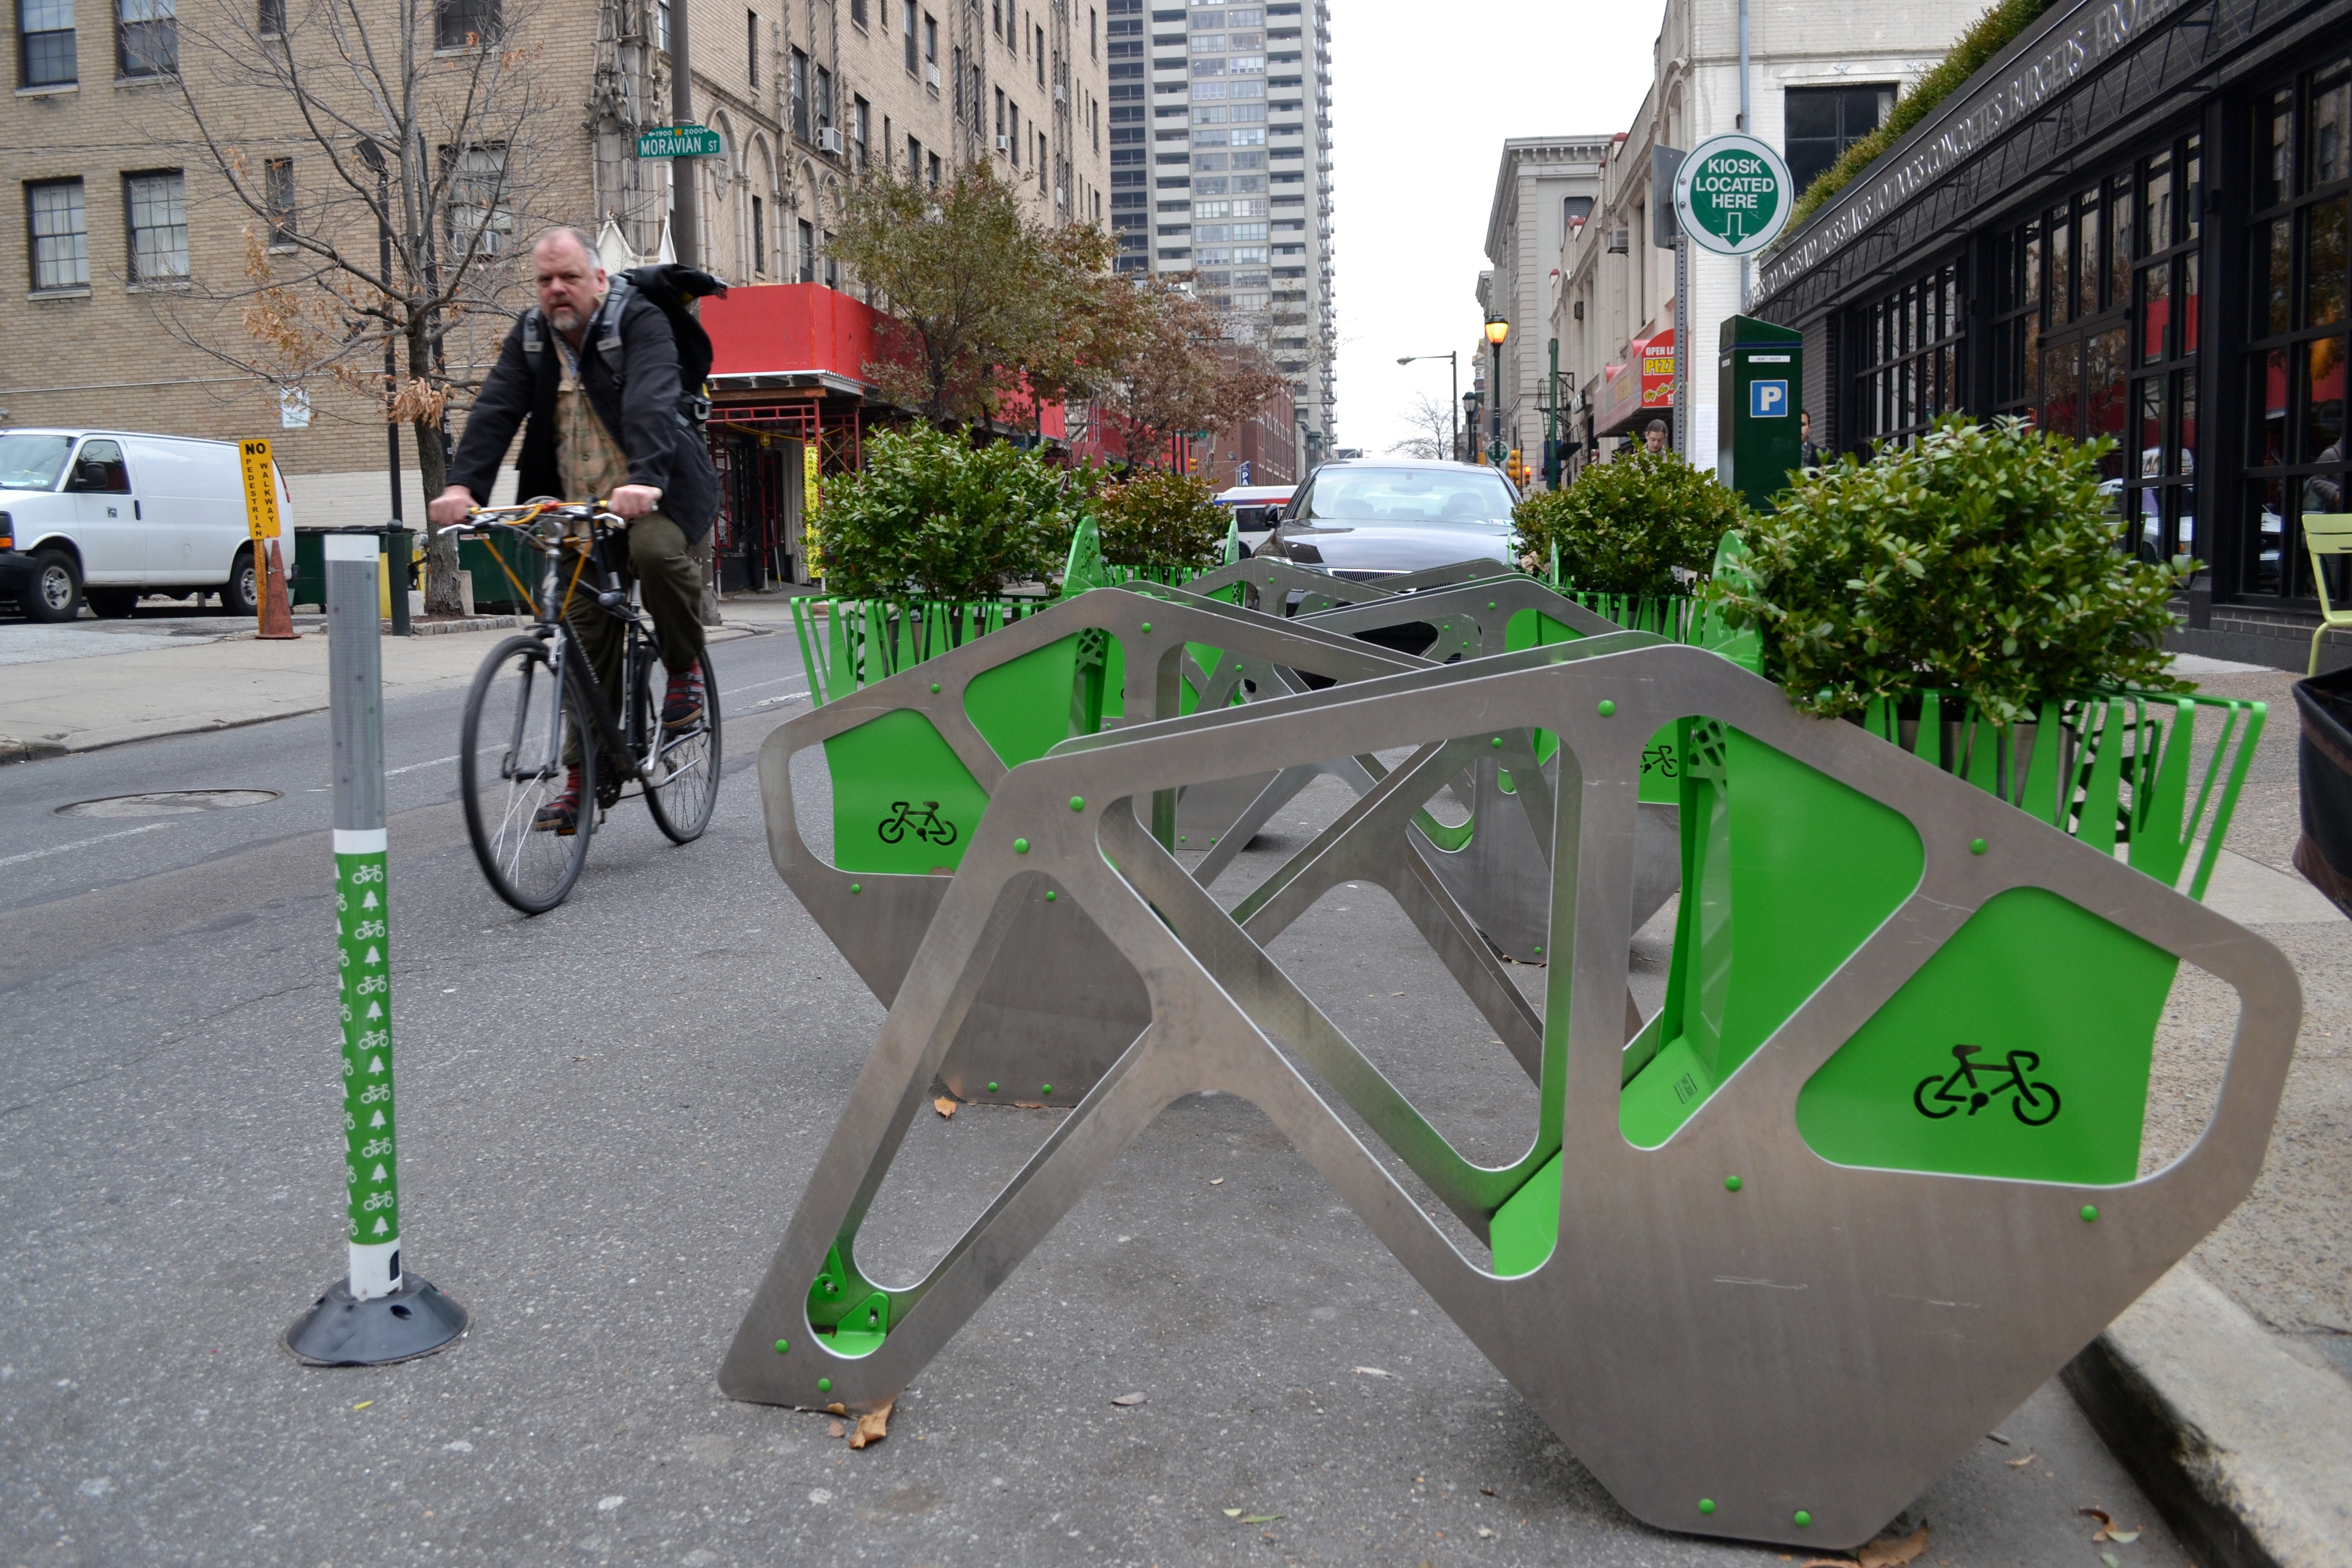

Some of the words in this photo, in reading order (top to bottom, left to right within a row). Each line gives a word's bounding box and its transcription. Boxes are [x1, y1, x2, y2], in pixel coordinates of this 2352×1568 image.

[1927, 92, 2003, 178] CONCRETES
[2008, 30, 2084, 119] BURGERS
[641, 137, 701, 155] MORAVIAN
[708, 140, 717, 152] ST
[1708, 159, 1762, 174] KIOSK
[1696, 177, 1775, 192] LOCATED
[1712, 193, 1758, 208] HERE
[1646, 347, 1665, 356] OPEN
[1645, 358, 1674, 374] PIZZ
[1761, 386, 1782, 411] P
[245, 443, 266, 455] NO
[246, 459, 262, 536] PEDESTRIAN
[260, 463, 274, 522] WALKWAY
